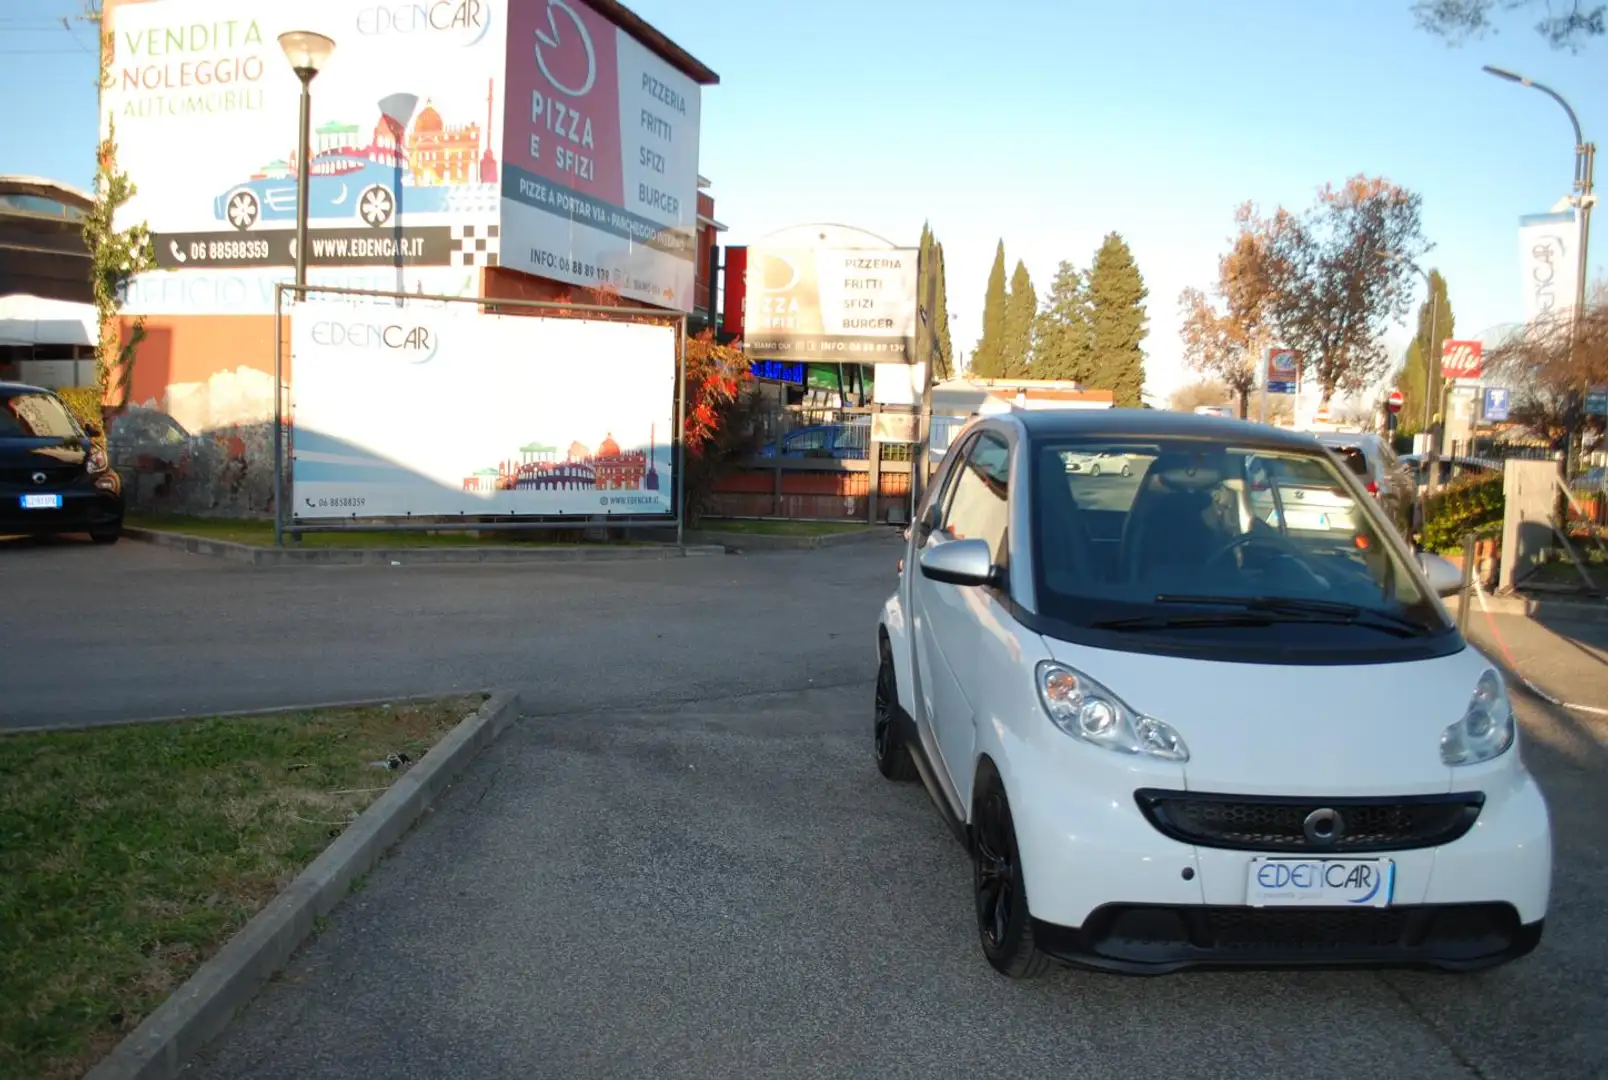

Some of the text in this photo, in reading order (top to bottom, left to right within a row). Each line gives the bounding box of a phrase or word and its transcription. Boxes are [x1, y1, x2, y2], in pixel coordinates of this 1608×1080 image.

[356, 0, 481, 36] EDENCAR
[124, 19, 262, 56] VENDITA
[122, 55, 264, 91] NOLEGGIO
[123, 89, 263, 118] AUTOMOBILI
[642, 72, 685, 117] PIZZERIA
[531, 90, 594, 150] PIZZA
[640, 109, 672, 142] FRITTI
[530, 134, 594, 181] E SFIZI
[640, 146, 665, 175] SFIZI
[520, 178, 546, 202] PIZZE
[548, 189, 556, 201] A
[556, 191, 591, 218] PORTAR
[592, 207, 606, 222] VIA
[638, 182, 679, 216] BURGER
[191, 240, 269, 260] 06 88588359
[312, 237, 425, 259] WWW.EDENCAR.IT
[530, 247, 557, 268] INFO:
[572, 260, 583, 276] 88
[845, 257, 902, 270] PIZZERIA
[844, 278, 883, 290] FRITTI
[843, 298, 873, 310] SFIZI
[312, 321, 430, 350] EDENCAR
[842, 318, 893, 330] BURGER
[1442, 344, 1480, 374] illy
[318, 497, 328, 507] 06
[1257, 863, 1371, 889] EDENCAR
